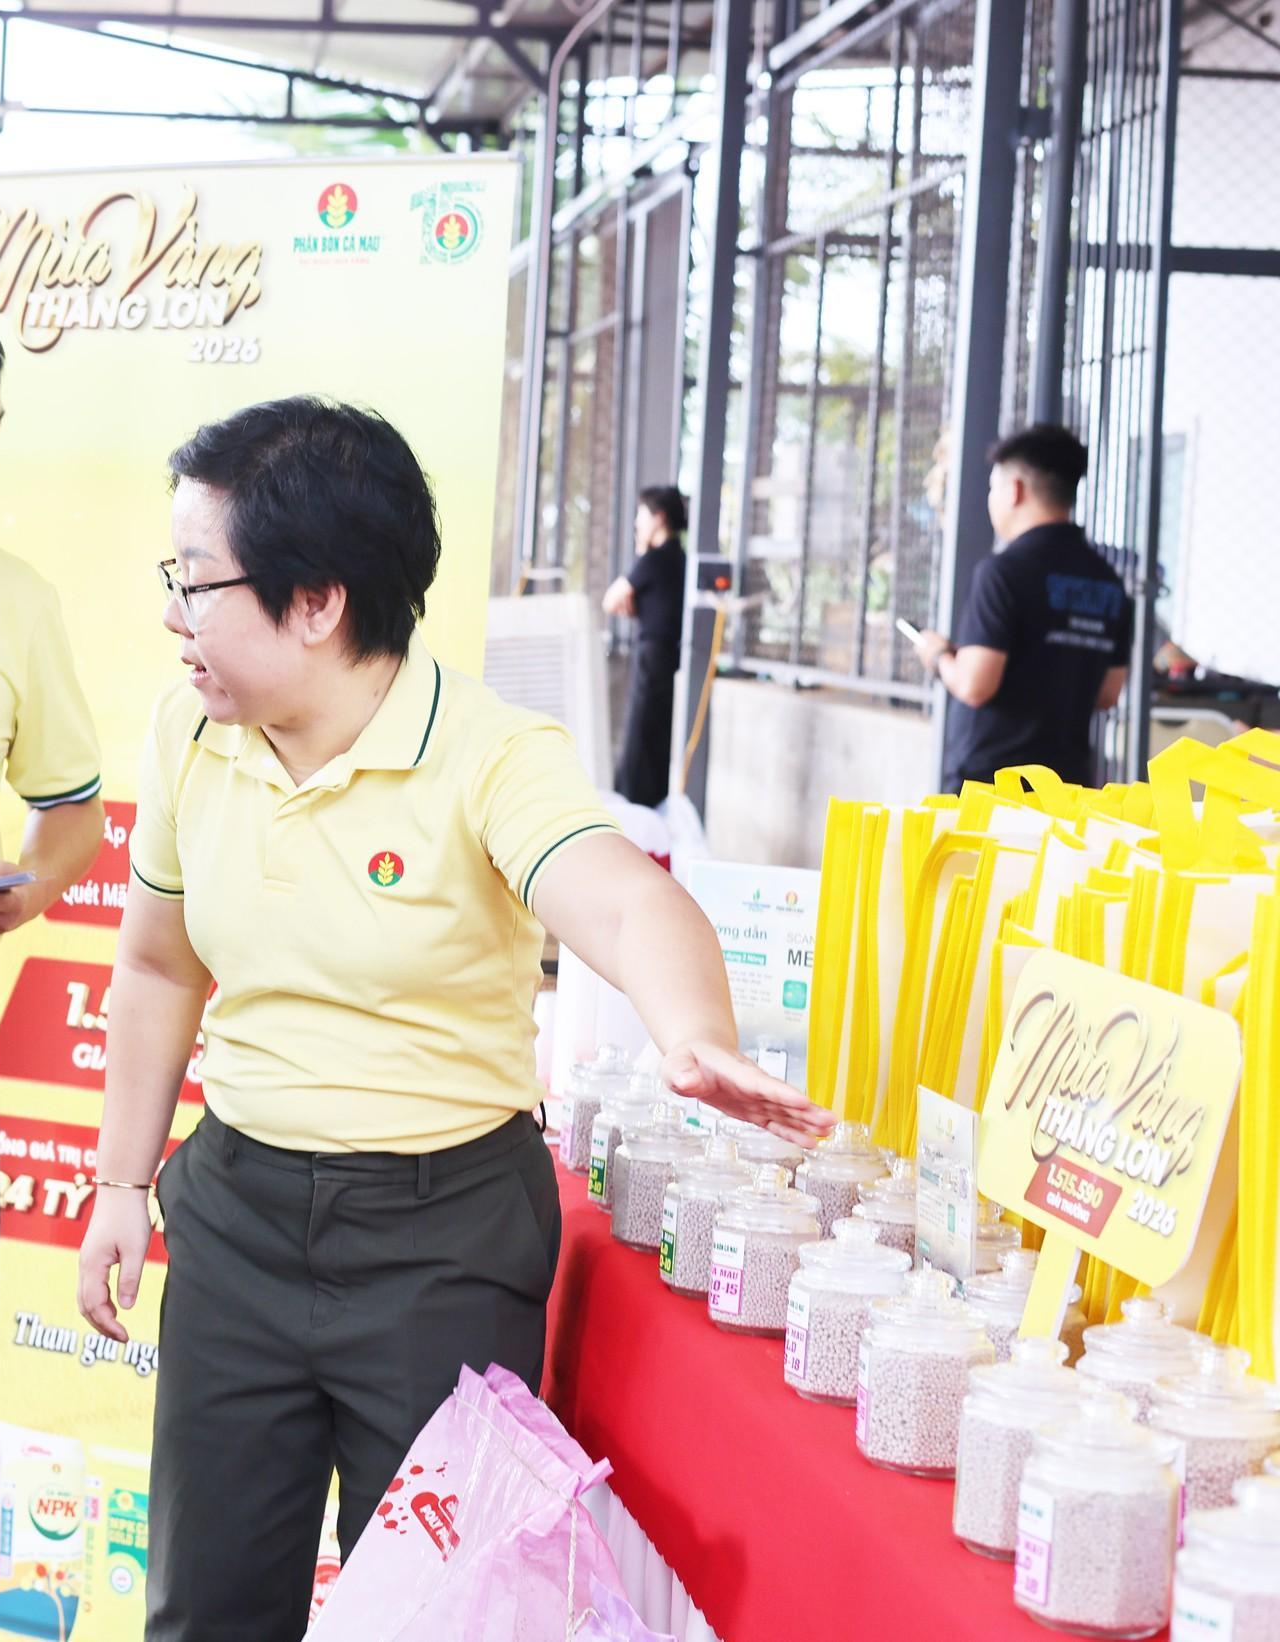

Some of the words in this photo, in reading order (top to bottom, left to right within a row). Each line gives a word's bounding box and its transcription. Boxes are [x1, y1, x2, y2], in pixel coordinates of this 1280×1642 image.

[359, 235, 381, 252] MAU
[186, 336, 262, 364] 2026
[1127, 1190, 1179, 1238] 2026
[720, 1268, 739, 1280] MAU
[14, 1310, 77, 1354] Tham
[80, 1332, 119, 1367] gia
[36, 1498, 78, 1518] NPK
